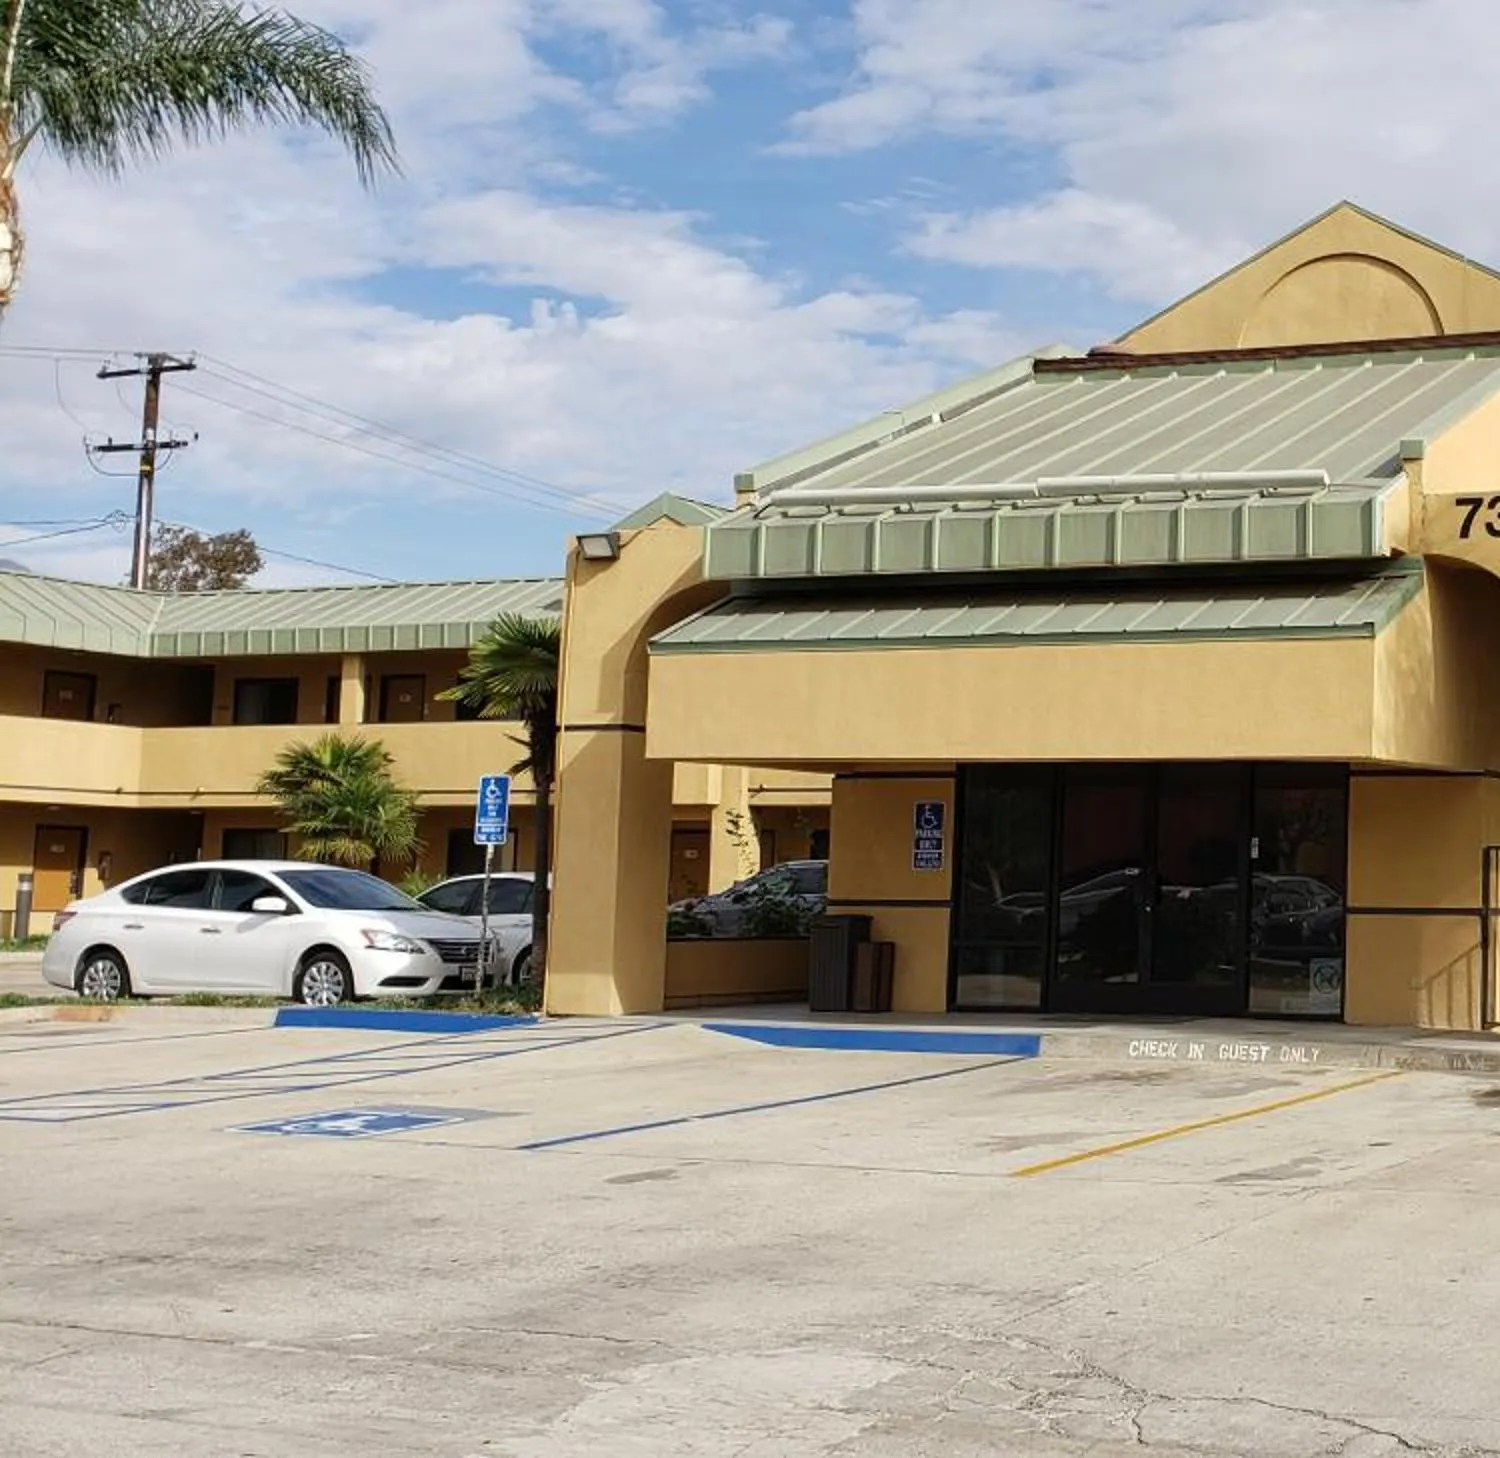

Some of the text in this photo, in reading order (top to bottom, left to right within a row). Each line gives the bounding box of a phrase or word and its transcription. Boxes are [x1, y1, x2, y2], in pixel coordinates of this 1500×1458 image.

[1129, 1040, 1322, 1062] CHECK IN GUEST ONLY
